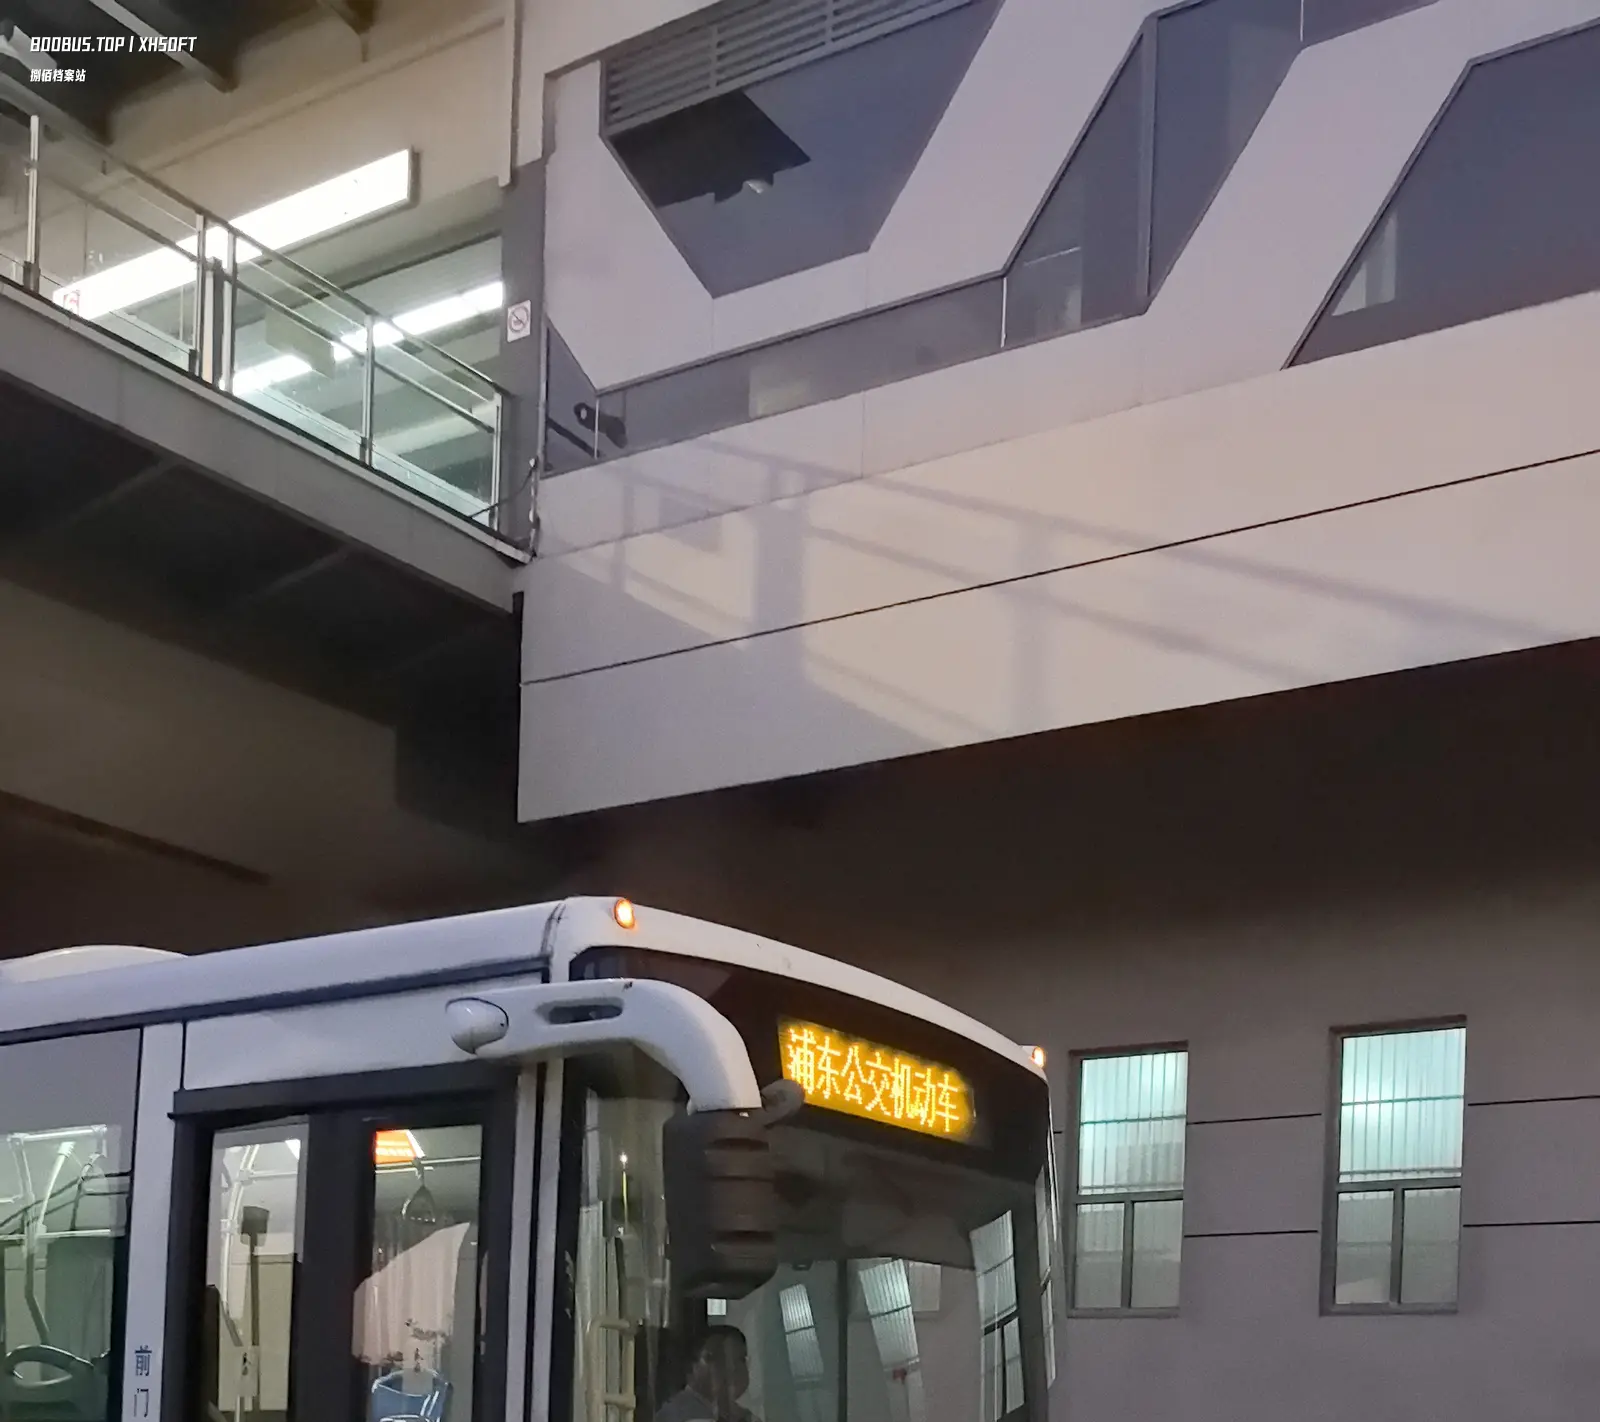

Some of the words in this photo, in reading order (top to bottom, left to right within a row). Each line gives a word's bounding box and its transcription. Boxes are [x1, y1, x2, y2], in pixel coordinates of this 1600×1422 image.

[787, 1028, 960, 1132] 浦东公交机动车
